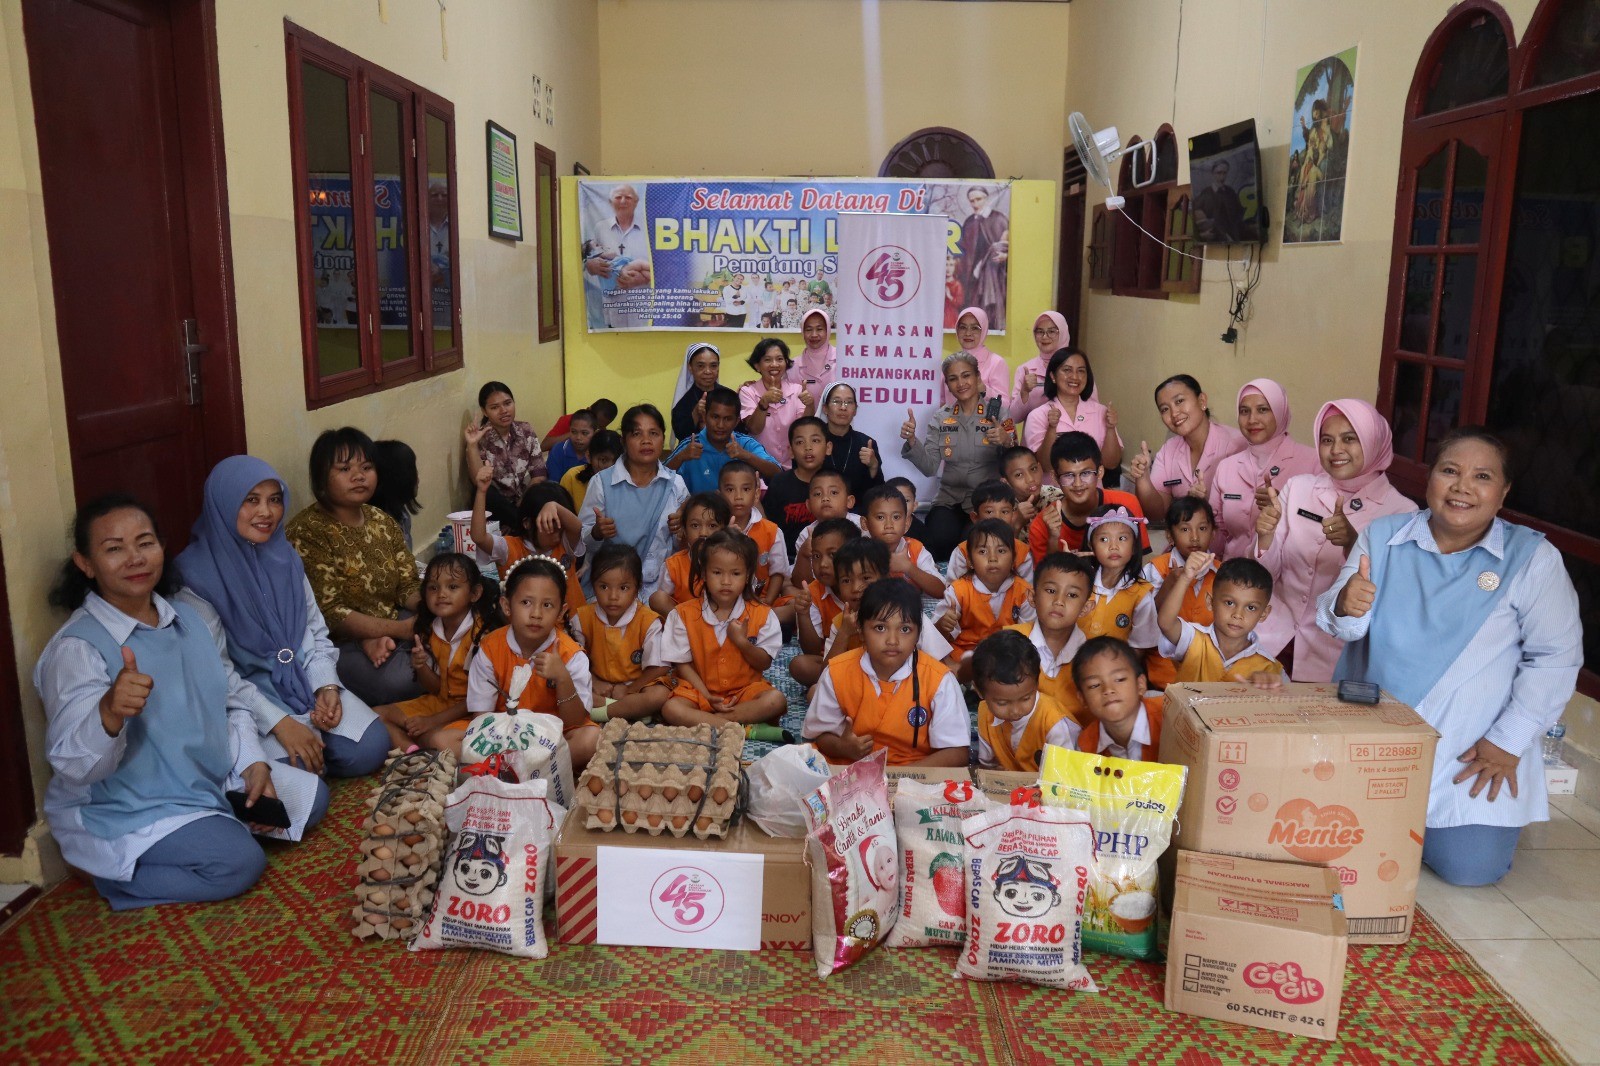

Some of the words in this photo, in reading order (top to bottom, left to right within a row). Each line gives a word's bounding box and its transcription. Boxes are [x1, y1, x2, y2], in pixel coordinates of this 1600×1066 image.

[690, 187, 793, 210] Selamat
[800, 189, 890, 213] Datang
[898, 188, 926, 211] Di
[654, 218, 810, 253] BHAKTI
[714, 256, 817, 275] Pematang
[866, 252, 905, 302] 45
[844, 323, 933, 338] YAYASAN
[845, 345, 933, 358] KEMALA
[842, 367, 935, 380] BHAYANGKARI
[855, 387, 933, 404] EDULI
[1356, 748, 1369, 756] 26
[1379, 747, 1417, 756] 228983
[1135, 799, 1166, 814] bulog
[857, 828, 865, 836] &
[1028, 834, 1057, 842] PILIHAN
[1268, 822, 1364, 845] Merries
[998, 843, 1022, 852] BERAS
[1023, 846, 1039, 854] R64
[524, 844, 538, 894] ZORO
[905, 850, 915, 883] BERAS
[971, 858, 982, 886] BERAS
[1208, 871, 1255, 882] TUMPUKAN
[1265, 880, 1309, 888] MAKSIMAL
[659, 874, 706, 925] 45
[971, 890, 980, 909] CAP
[1075, 865, 1087, 916] ZORO
[447, 896, 511, 924] ZORO
[525, 898, 534, 916] CAP
[939, 920, 955, 929] CAP
[1255, 913, 1298, 922] DIBANTING
[442, 929, 481, 940] JAMINAN
[526, 918, 536, 947] BERAS
[925, 927, 950, 938] MUTU
[967, 914, 981, 966] ZORO
[994, 923, 1065, 944] ZORO
[988, 957, 1033, 965] JAMINAN
[1249, 965, 1298, 985] Get
[1227, 1003, 1240, 1011] 60
[1243, 1005, 1286, 1019] SACHET
[1300, 1016, 1313, 1025] 42
